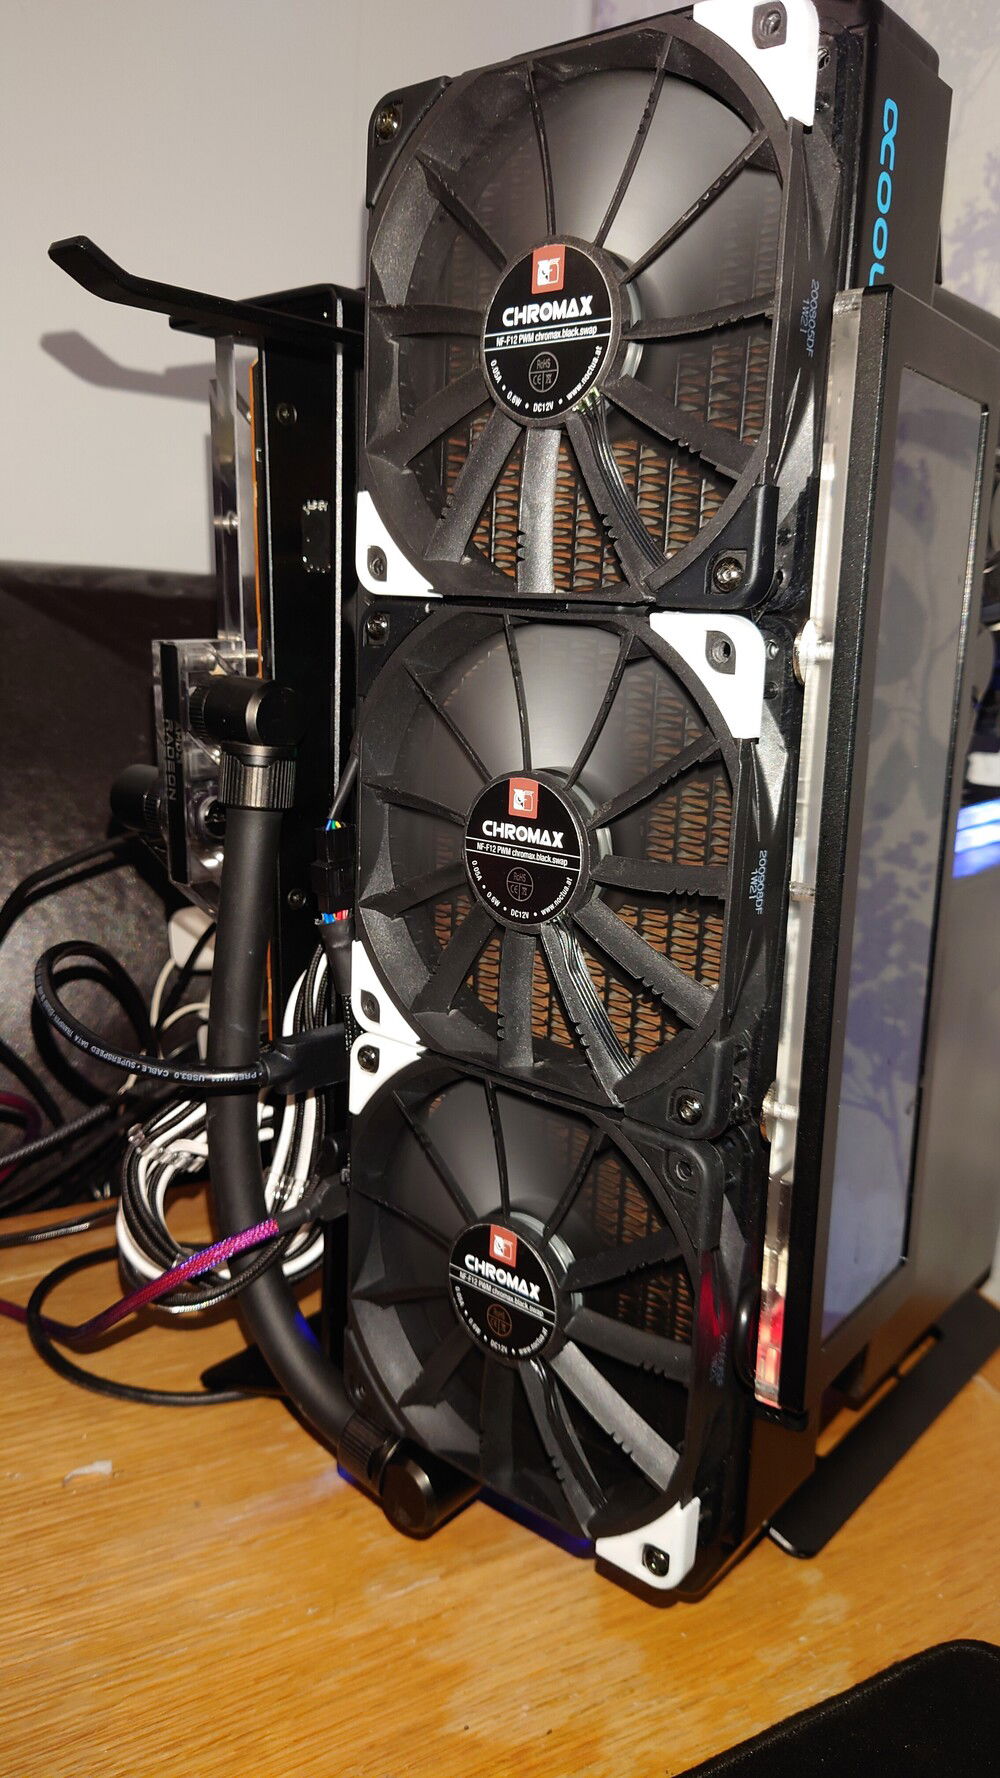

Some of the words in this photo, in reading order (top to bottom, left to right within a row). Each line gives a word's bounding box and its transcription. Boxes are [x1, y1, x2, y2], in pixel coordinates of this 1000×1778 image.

[502, 295, 593, 327] CHROMAX
[496, 334, 518, 347] NF-F12
[518, 331, 535, 345] PWM
[535, 325, 598, 343] chromax.black.swap
[506, 390, 522, 407] 0.6W
[532, 401, 554, 413] DC12V
[565, 345, 603, 401] www.noctua.at
[482, 819, 564, 849] CHROMAX
[476, 841, 497, 853] NF-F12
[497, 845, 512, 857] PWM
[511, 848, 568, 867] chromax.black.swap
[510, 908, 530, 919] DC12V
[540, 877, 574, 916] www.noctua.at
[73, 1035, 90, 1048] DATA
[91, 1046, 137, 1069] SUPERSPEED
[141, 1064, 170, 1078] CABLE
[464, 1253, 541, 1302] CHROMAX
